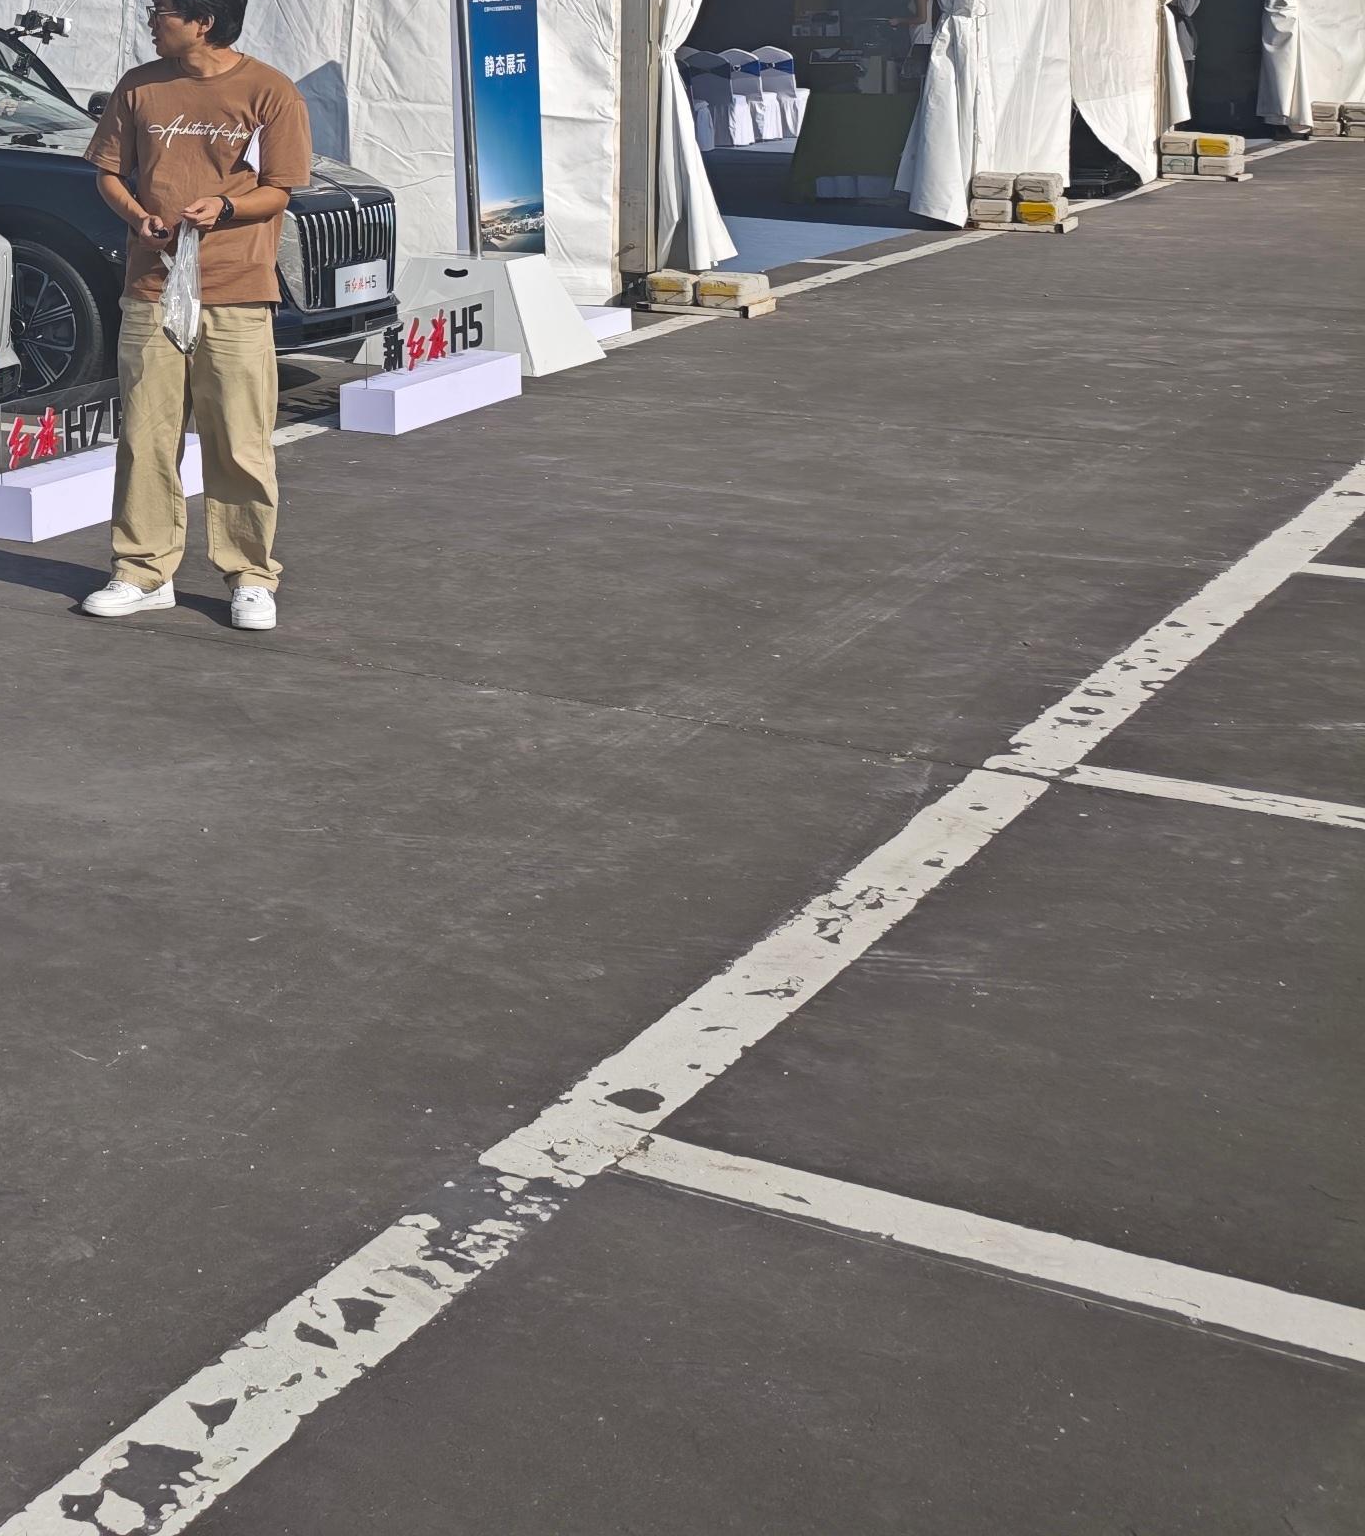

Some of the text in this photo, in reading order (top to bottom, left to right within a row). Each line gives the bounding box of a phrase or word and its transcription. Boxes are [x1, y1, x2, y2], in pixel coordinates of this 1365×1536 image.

[484, 53, 527, 78] 静态展示
[148, 114, 212, 148] Architect
[210, 123, 227, 144] of
[382, 303, 483, 372] 新红旗H5
